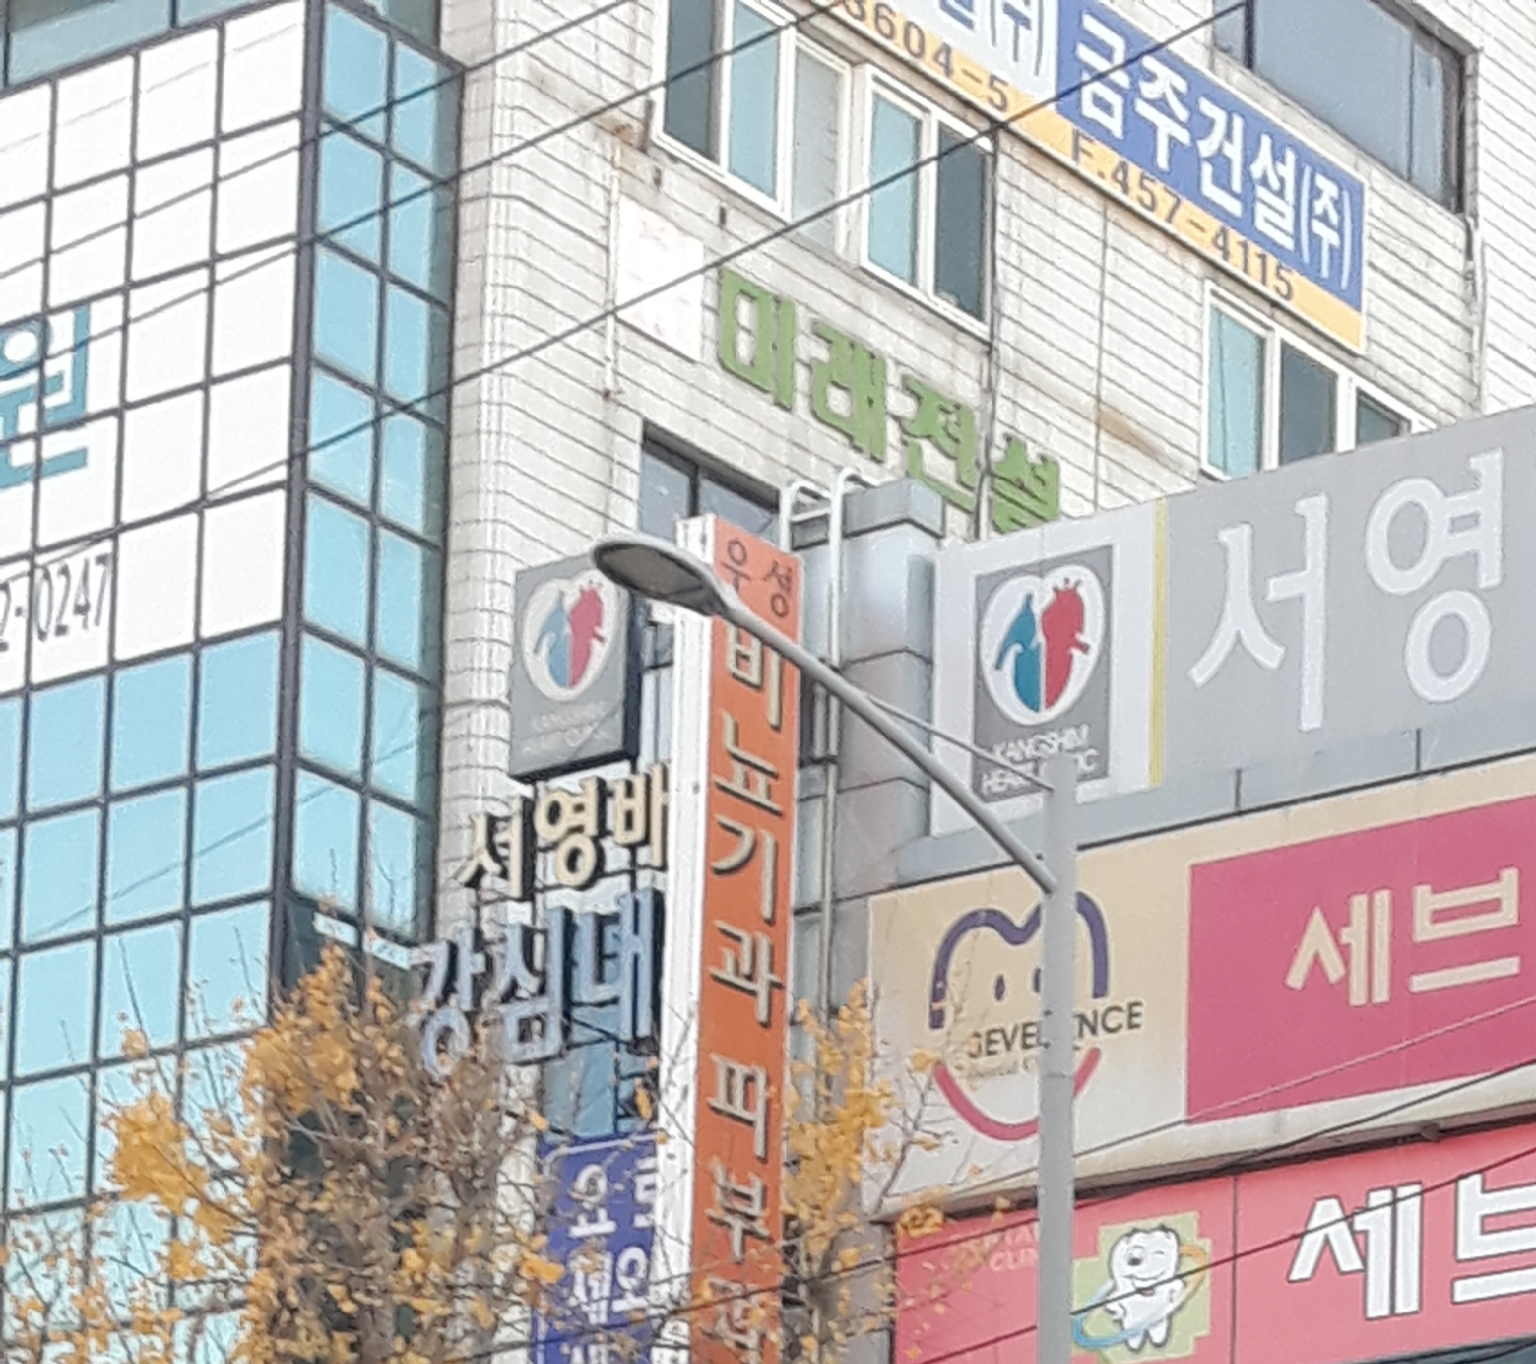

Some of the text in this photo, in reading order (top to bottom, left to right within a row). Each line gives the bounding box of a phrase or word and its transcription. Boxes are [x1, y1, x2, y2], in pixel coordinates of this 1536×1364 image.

[1071, 128, 1296, 301] F.457-4115
[1079, 8, 1353, 290] 금주건설(주)
[967, 1000, 1144, 1058] SEVENCE
